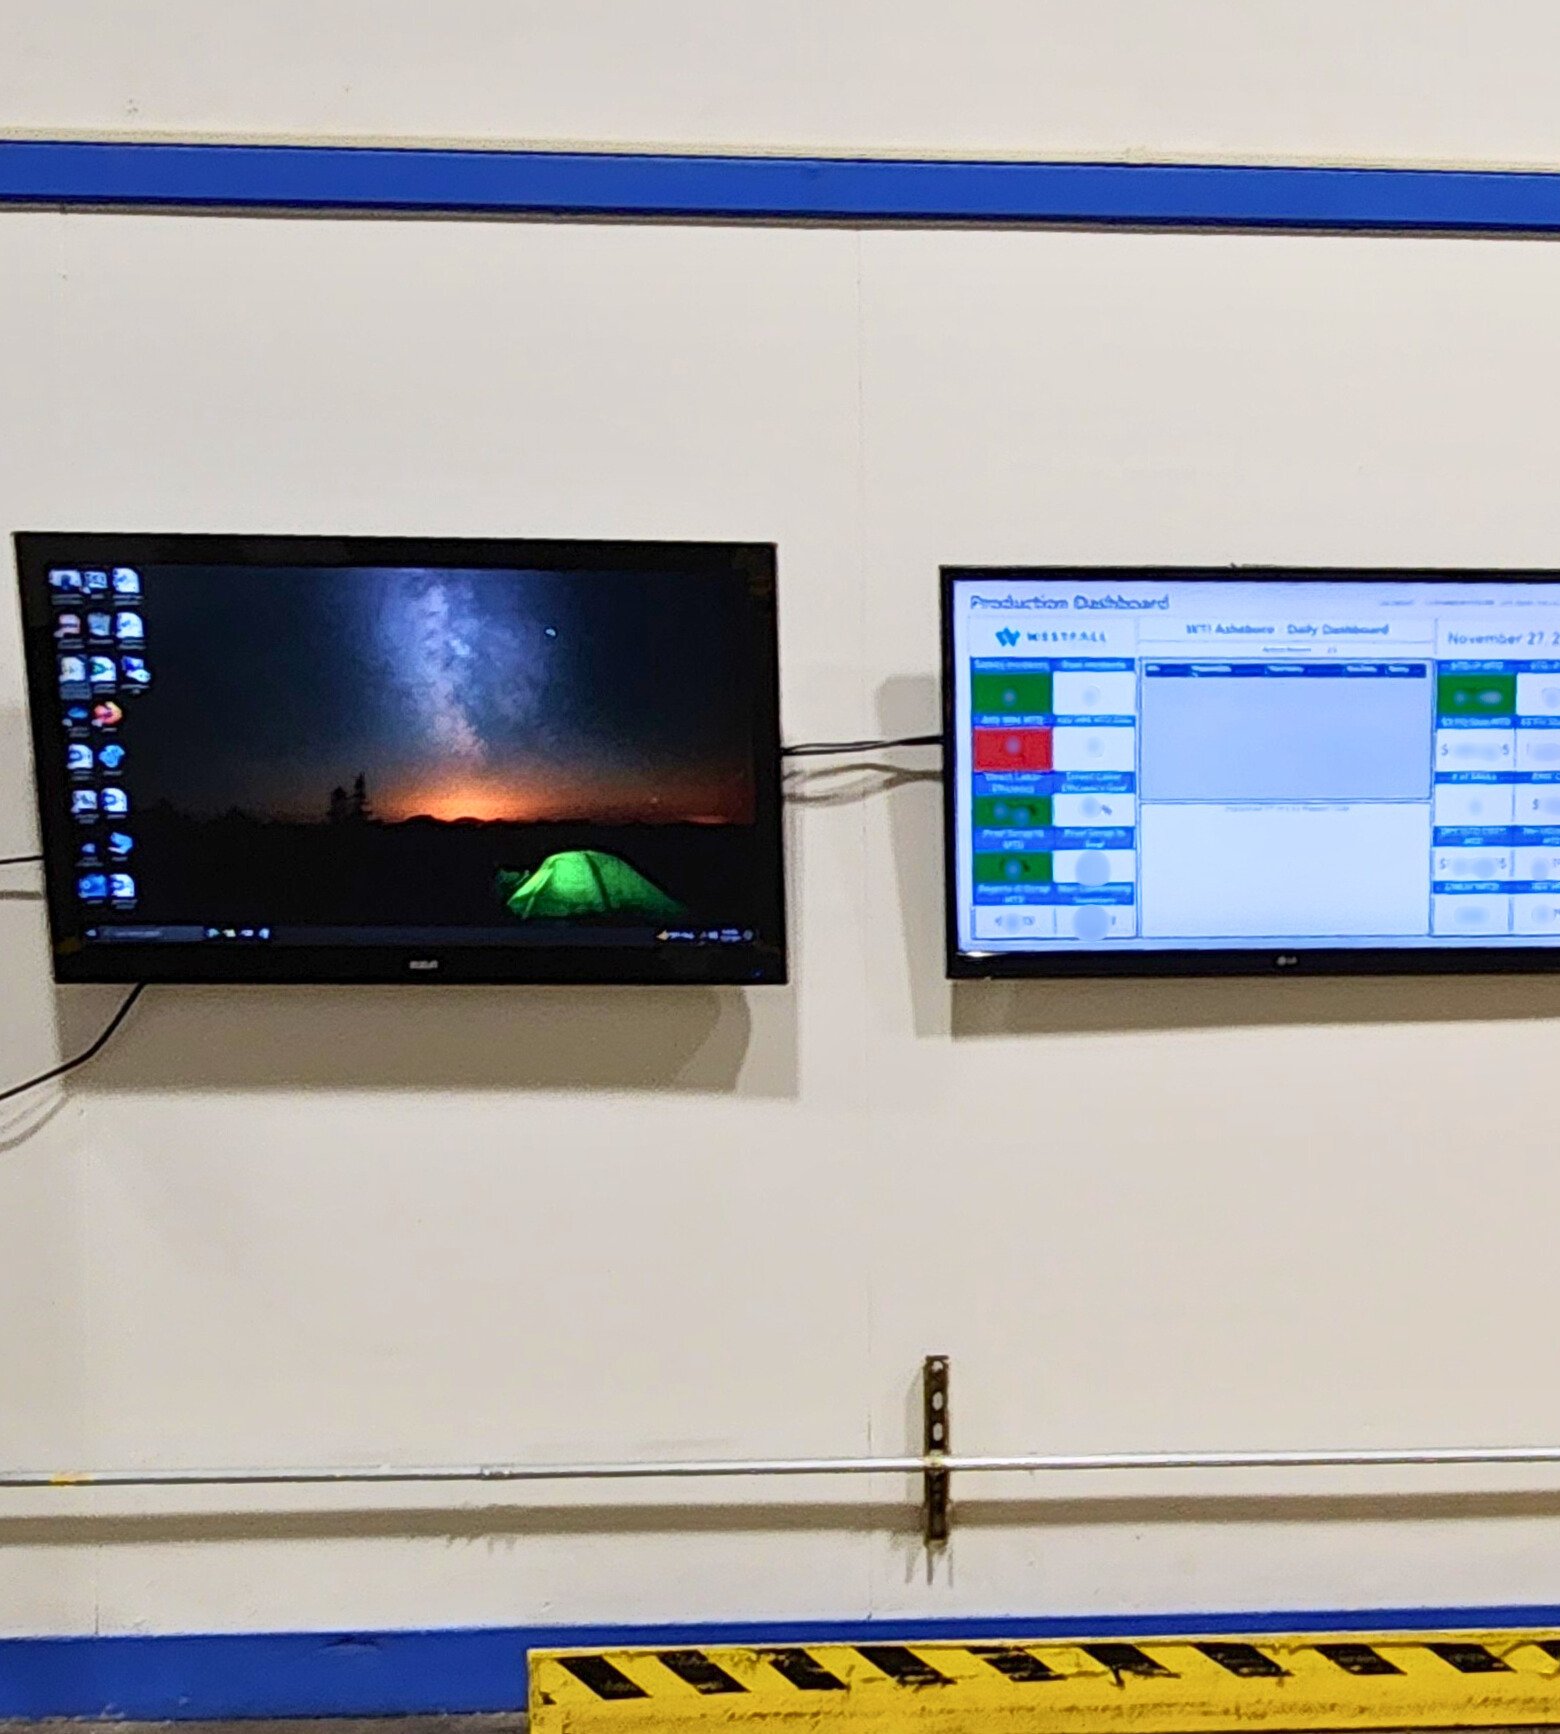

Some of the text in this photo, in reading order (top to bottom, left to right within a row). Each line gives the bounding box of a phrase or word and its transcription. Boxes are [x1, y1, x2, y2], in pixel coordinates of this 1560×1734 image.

[970, 595, 1170, 610] Production Dashboard
[1287, 623, 1318, 637] Daily
[1322, 623, 1390, 636] Dashboard
[1447, 631, 1522, 645] November
